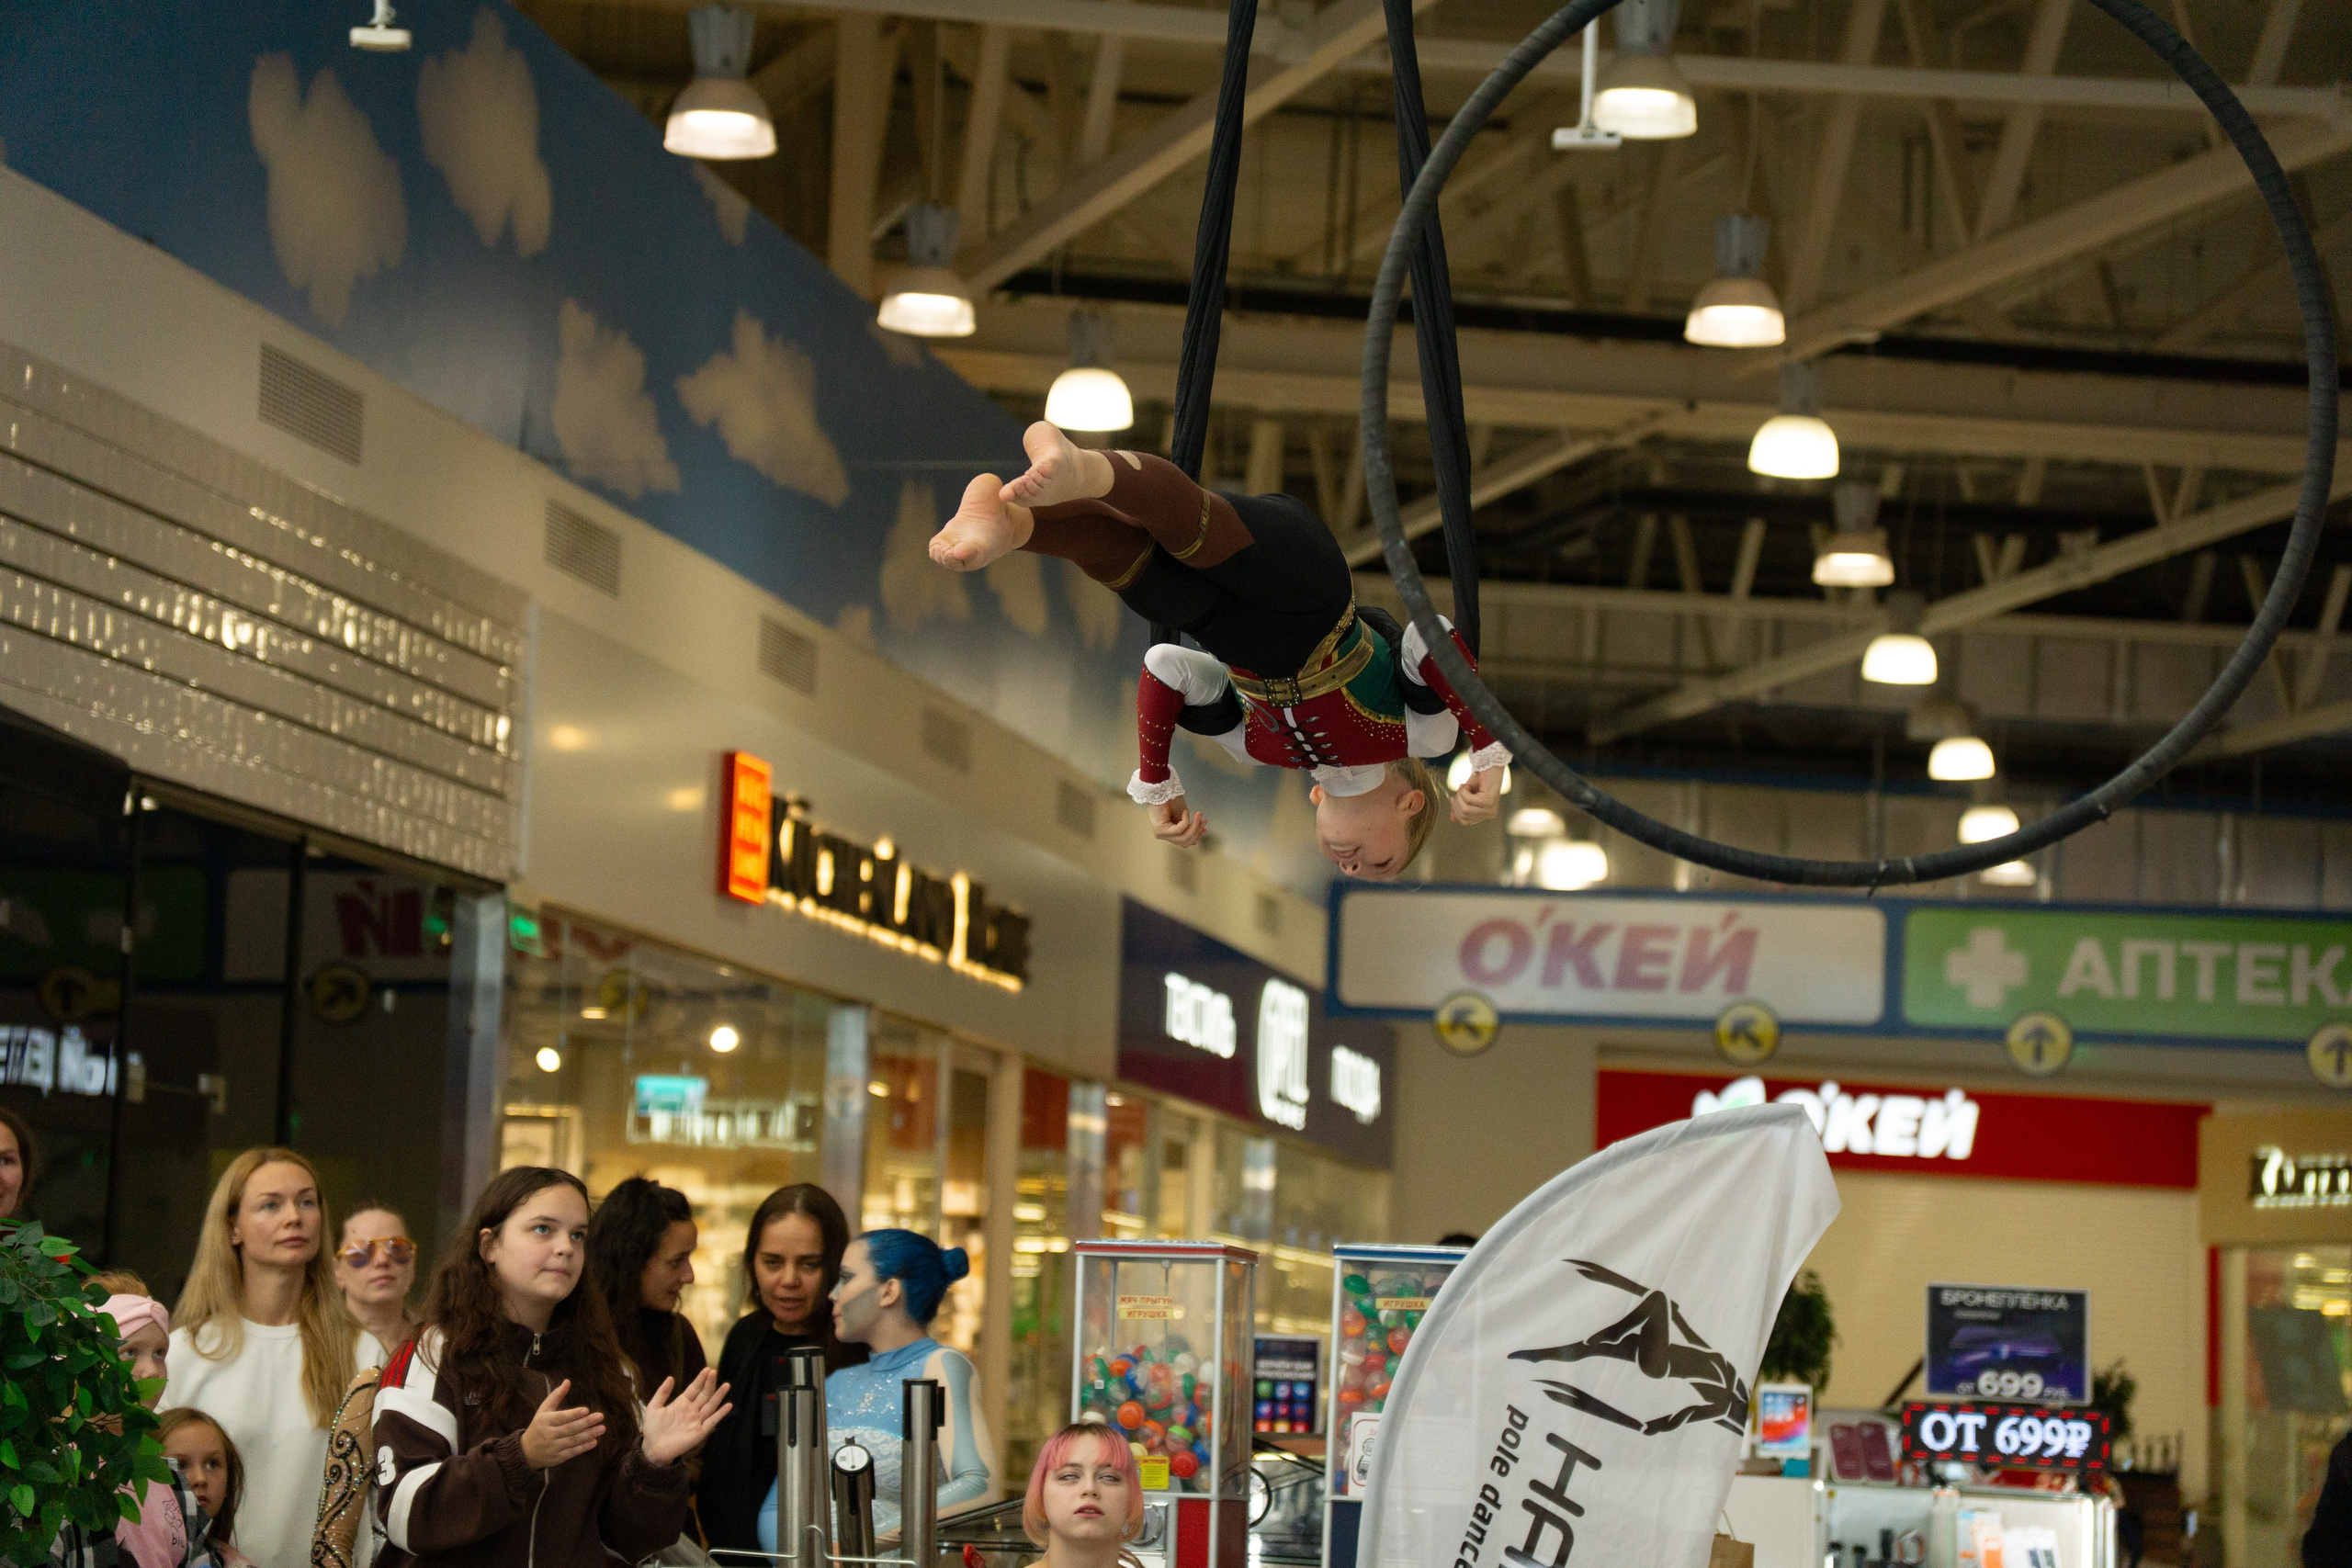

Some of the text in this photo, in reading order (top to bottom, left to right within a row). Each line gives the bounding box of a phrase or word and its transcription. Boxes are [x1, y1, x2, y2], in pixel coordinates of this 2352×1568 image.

[1457, 904, 1759, 995] О'КЕЙ
[2056, 935, 2352, 1008] АПТЕК
[1126, 1310, 1168, 1318] ИГРУШКА
[1383, 1299, 1425, 1308] ИГРУШКА
[1977, 1371, 2044, 1398] 699
[1489, 1404, 1530, 1478] pole
[1919, 1411, 1987, 1451] ОТ
[377, 1445, 396, 1486] 3
[1498, 1432, 1602, 1568] HA
